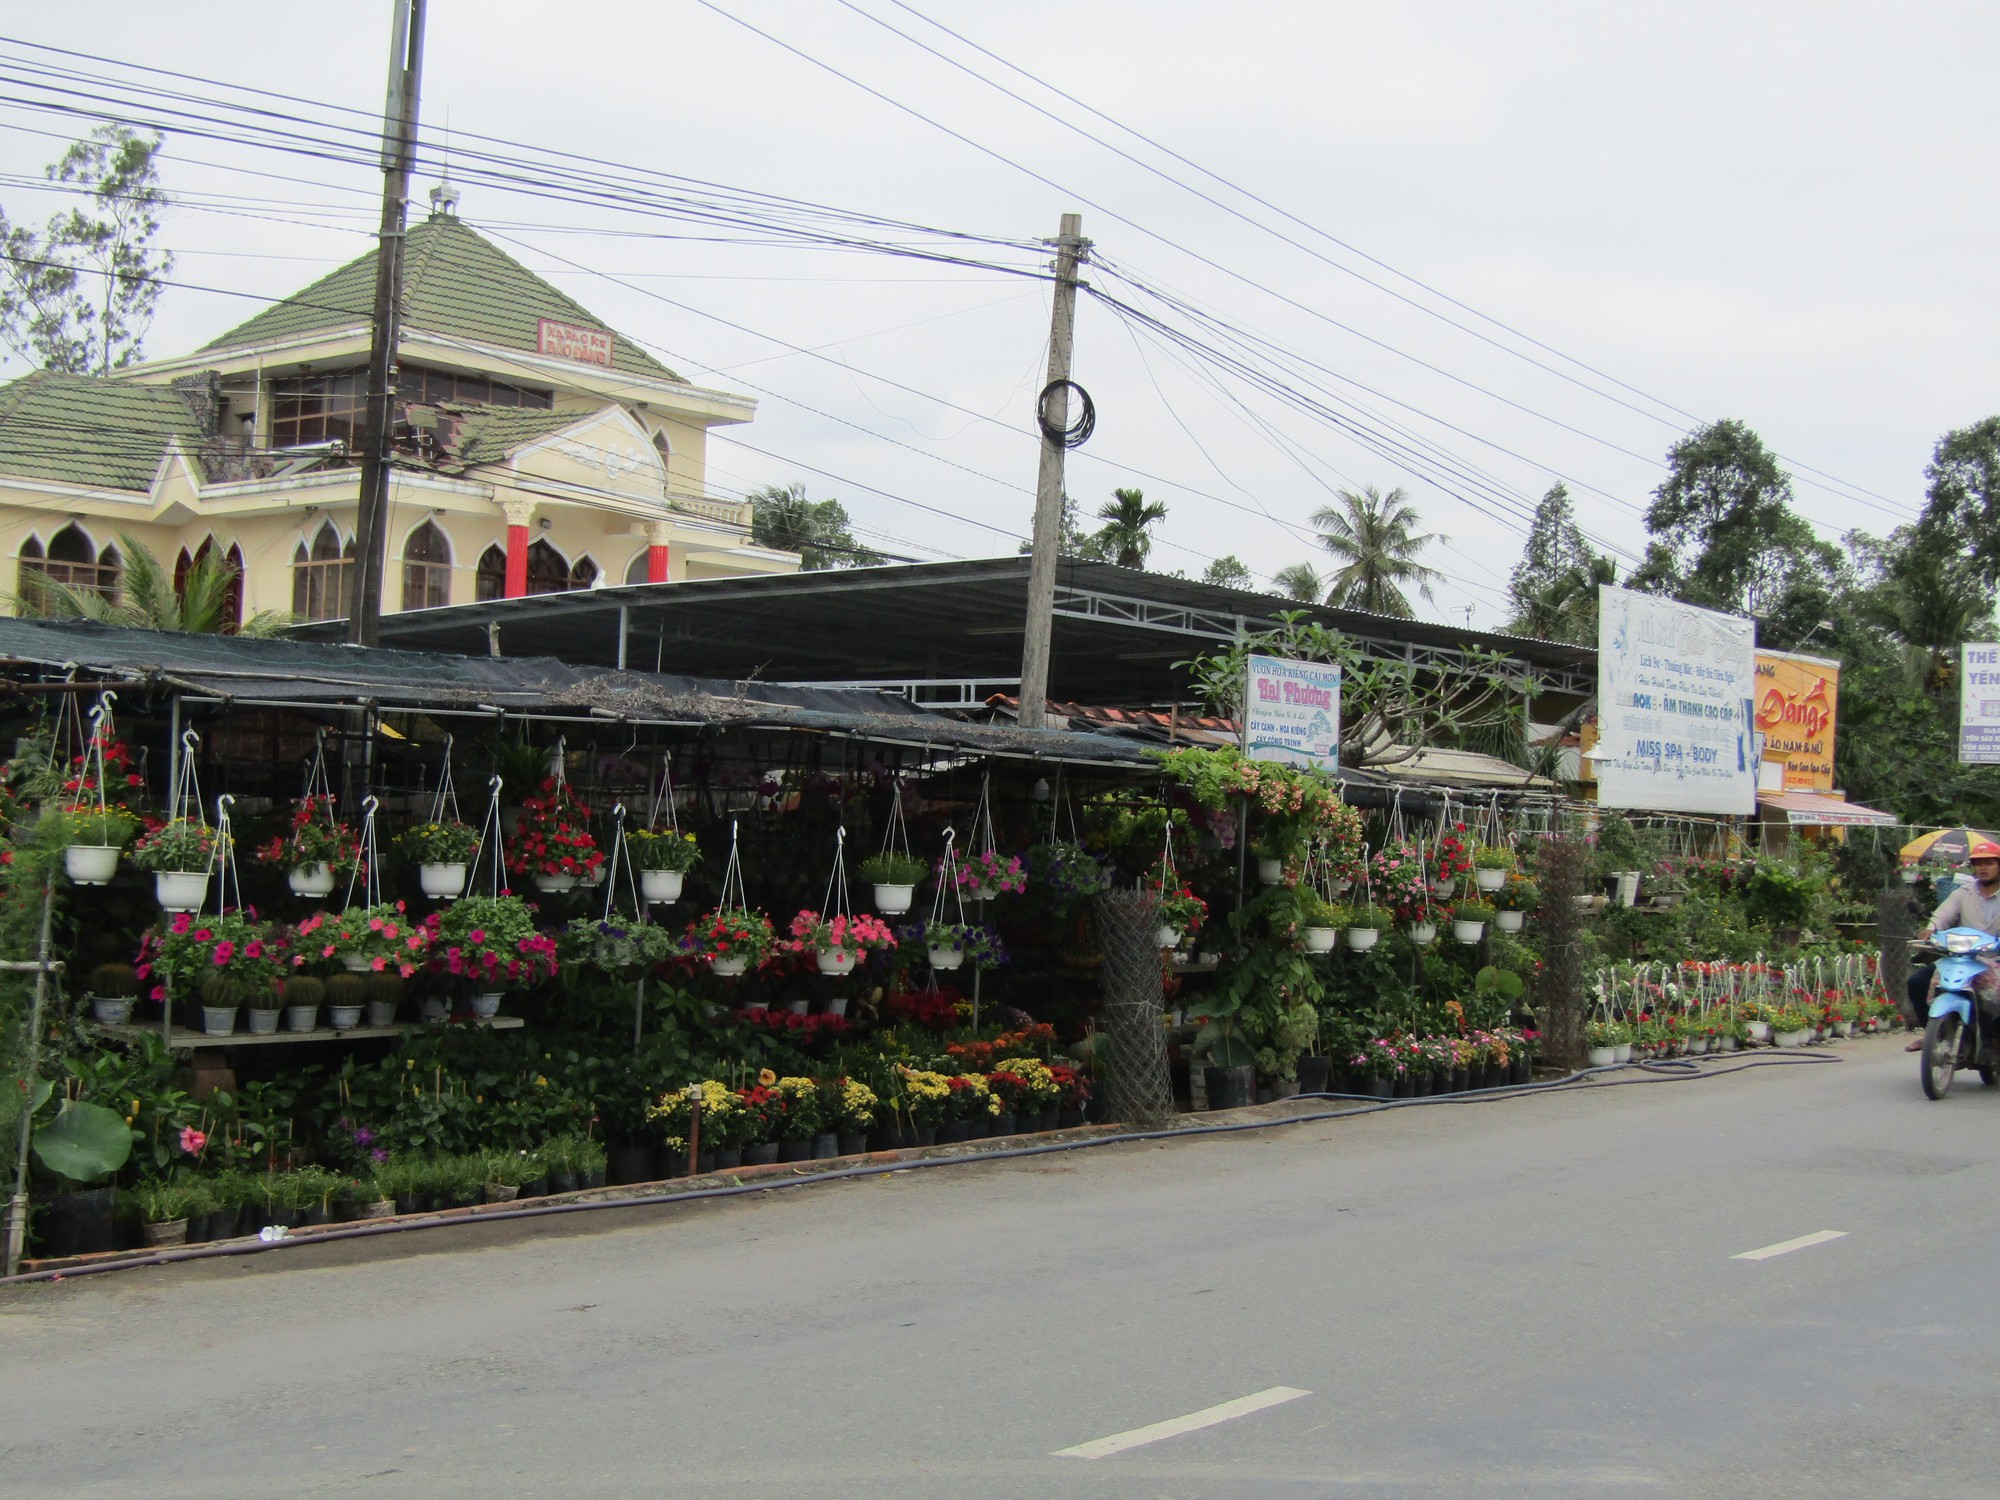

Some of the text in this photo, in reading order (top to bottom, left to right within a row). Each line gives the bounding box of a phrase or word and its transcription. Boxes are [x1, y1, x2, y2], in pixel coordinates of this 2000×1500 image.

[1967, 647, 1999, 664] THẾ
[1272, 666, 1287, 677] HOA
[1968, 669, 2000, 685] YẾN
[1257, 677, 1333, 712] Hai Phương
[1663, 694, 1677, 713] ÂM
[1678, 699, 1703, 717] THANH
[1705, 703, 1719, 720] CAO
[1719, 701, 1734, 721] CẤP
[1755, 688, 1819, 738] Đăng
[1279, 725, 1290, 734] HOA
[1636, 739, 1661, 758] MISS
[1664, 742, 1683, 760] SPA
[1693, 746, 1718, 763] BODY
[1770, 735, 1781, 751] ÁO
[1783, 739, 1803, 753] NAM
